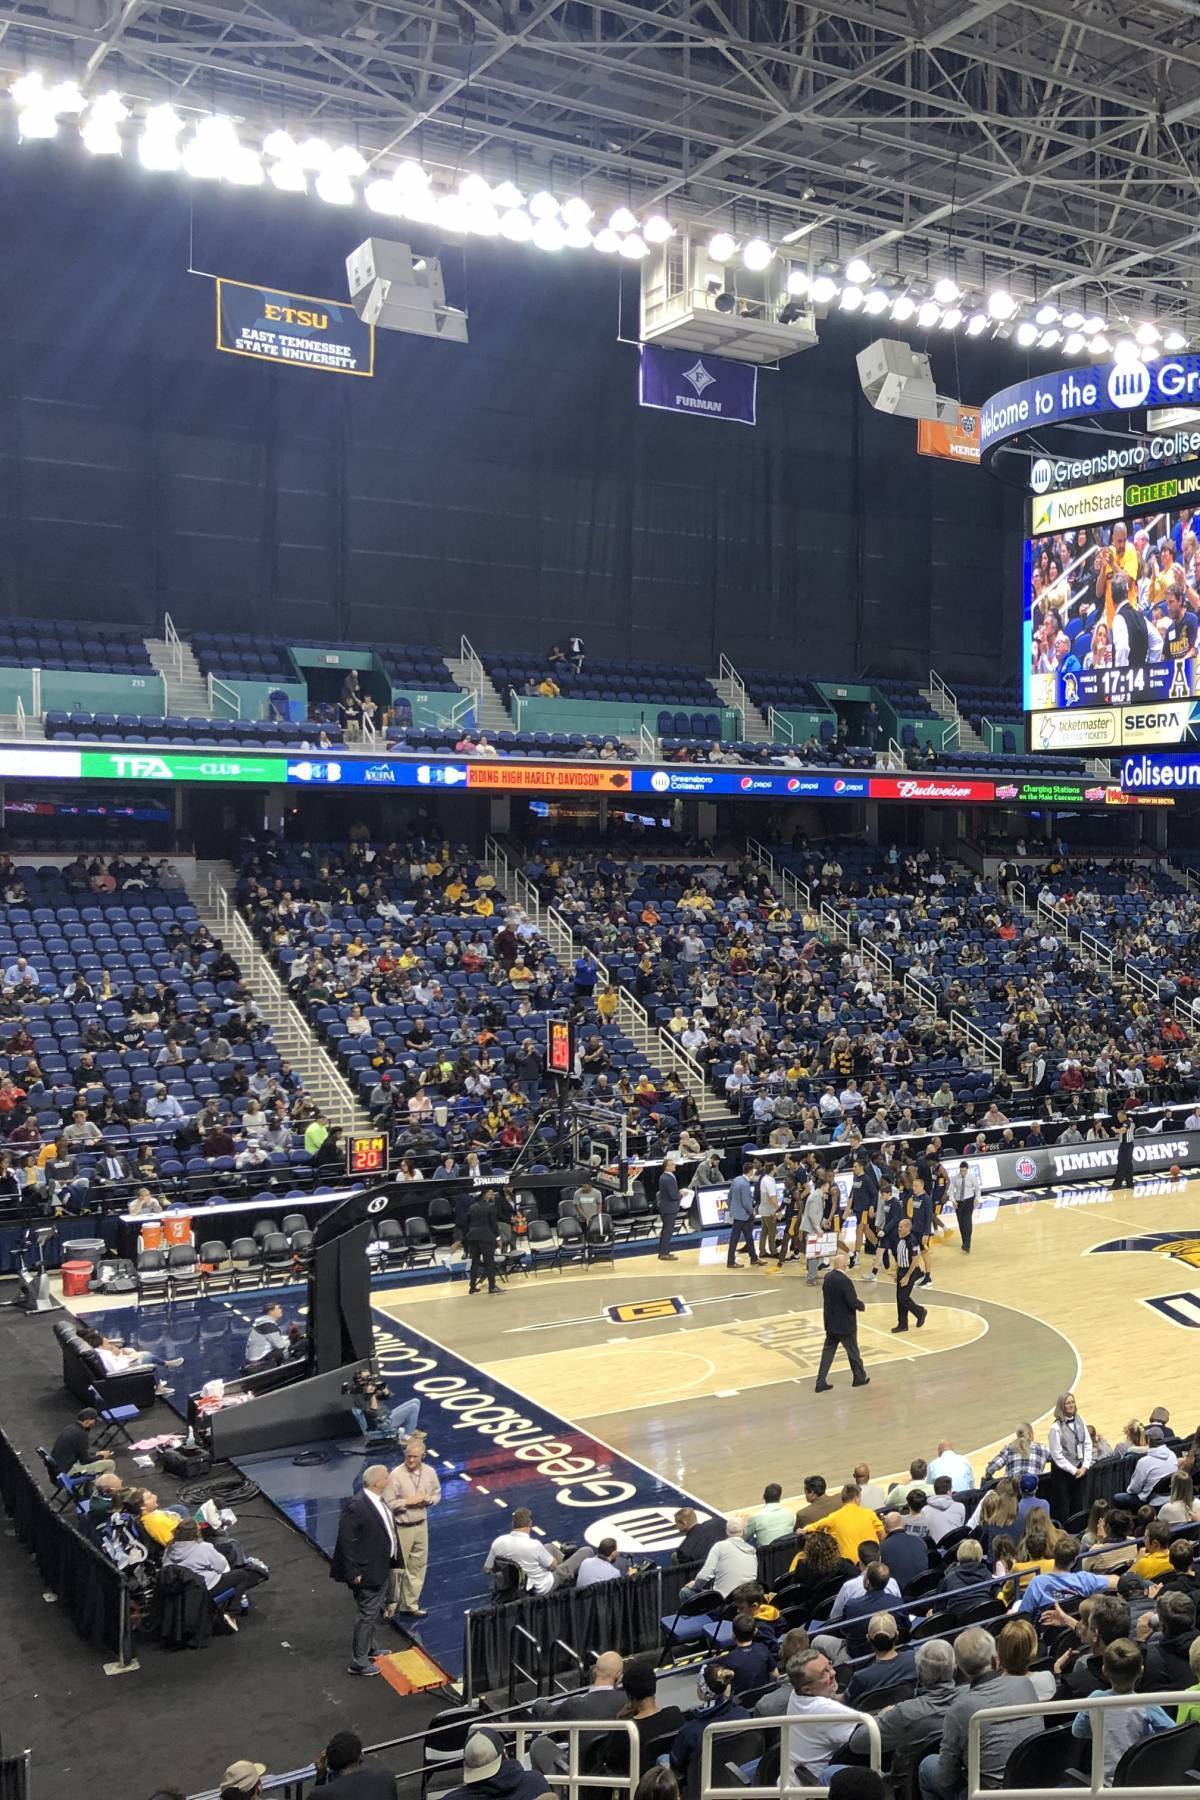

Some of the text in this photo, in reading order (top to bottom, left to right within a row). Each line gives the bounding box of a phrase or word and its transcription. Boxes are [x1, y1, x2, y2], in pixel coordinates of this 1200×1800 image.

[264, 304, 328, 329] ETSU
[241, 328, 351, 358] EAST TENNESSEE
[235, 339, 357, 369] STATE UNIVERSITY
[676, 396, 722, 413] FURMAN
[1035, 390, 1053, 416] to
[1061, 376, 1097, 409] the
[950, 443, 981, 458] MERCE
[1055, 447, 1145, 483] Greensboro
[1125, 479, 1178, 507] GREEN
[1058, 492, 1122, 519] NorthState
[1102, 668, 1145, 693] 17:14
[1059, 718, 1110, 732] ticketmaster
[1124, 713, 1180, 731] SEGRA
[110, 755, 241, 778] TFA CLUB
[469, 768, 499, 783] RIDING
[501, 769, 522, 784] HIGH
[671, 774, 713, 784] Greensboro
[753, 780, 772, 789] pepsi
[671, 781, 704, 790] Coliseum
[799, 782, 818, 790] pepsi
[845, 784, 863, 792] pepsi
[896, 781, 972, 798] Budweiser
[1023, 785, 1052, 794] Charging
[1053, 786, 1080, 794] Stations
[356, 1152, 378, 1168] 20
[1053, 1149, 1121, 1176] JIMMY
[1132, 1142, 1190, 1162] OHN'S
[473, 1176, 510, 1187] SPALDING
[413, 1376, 638, 1508] Greensboro
